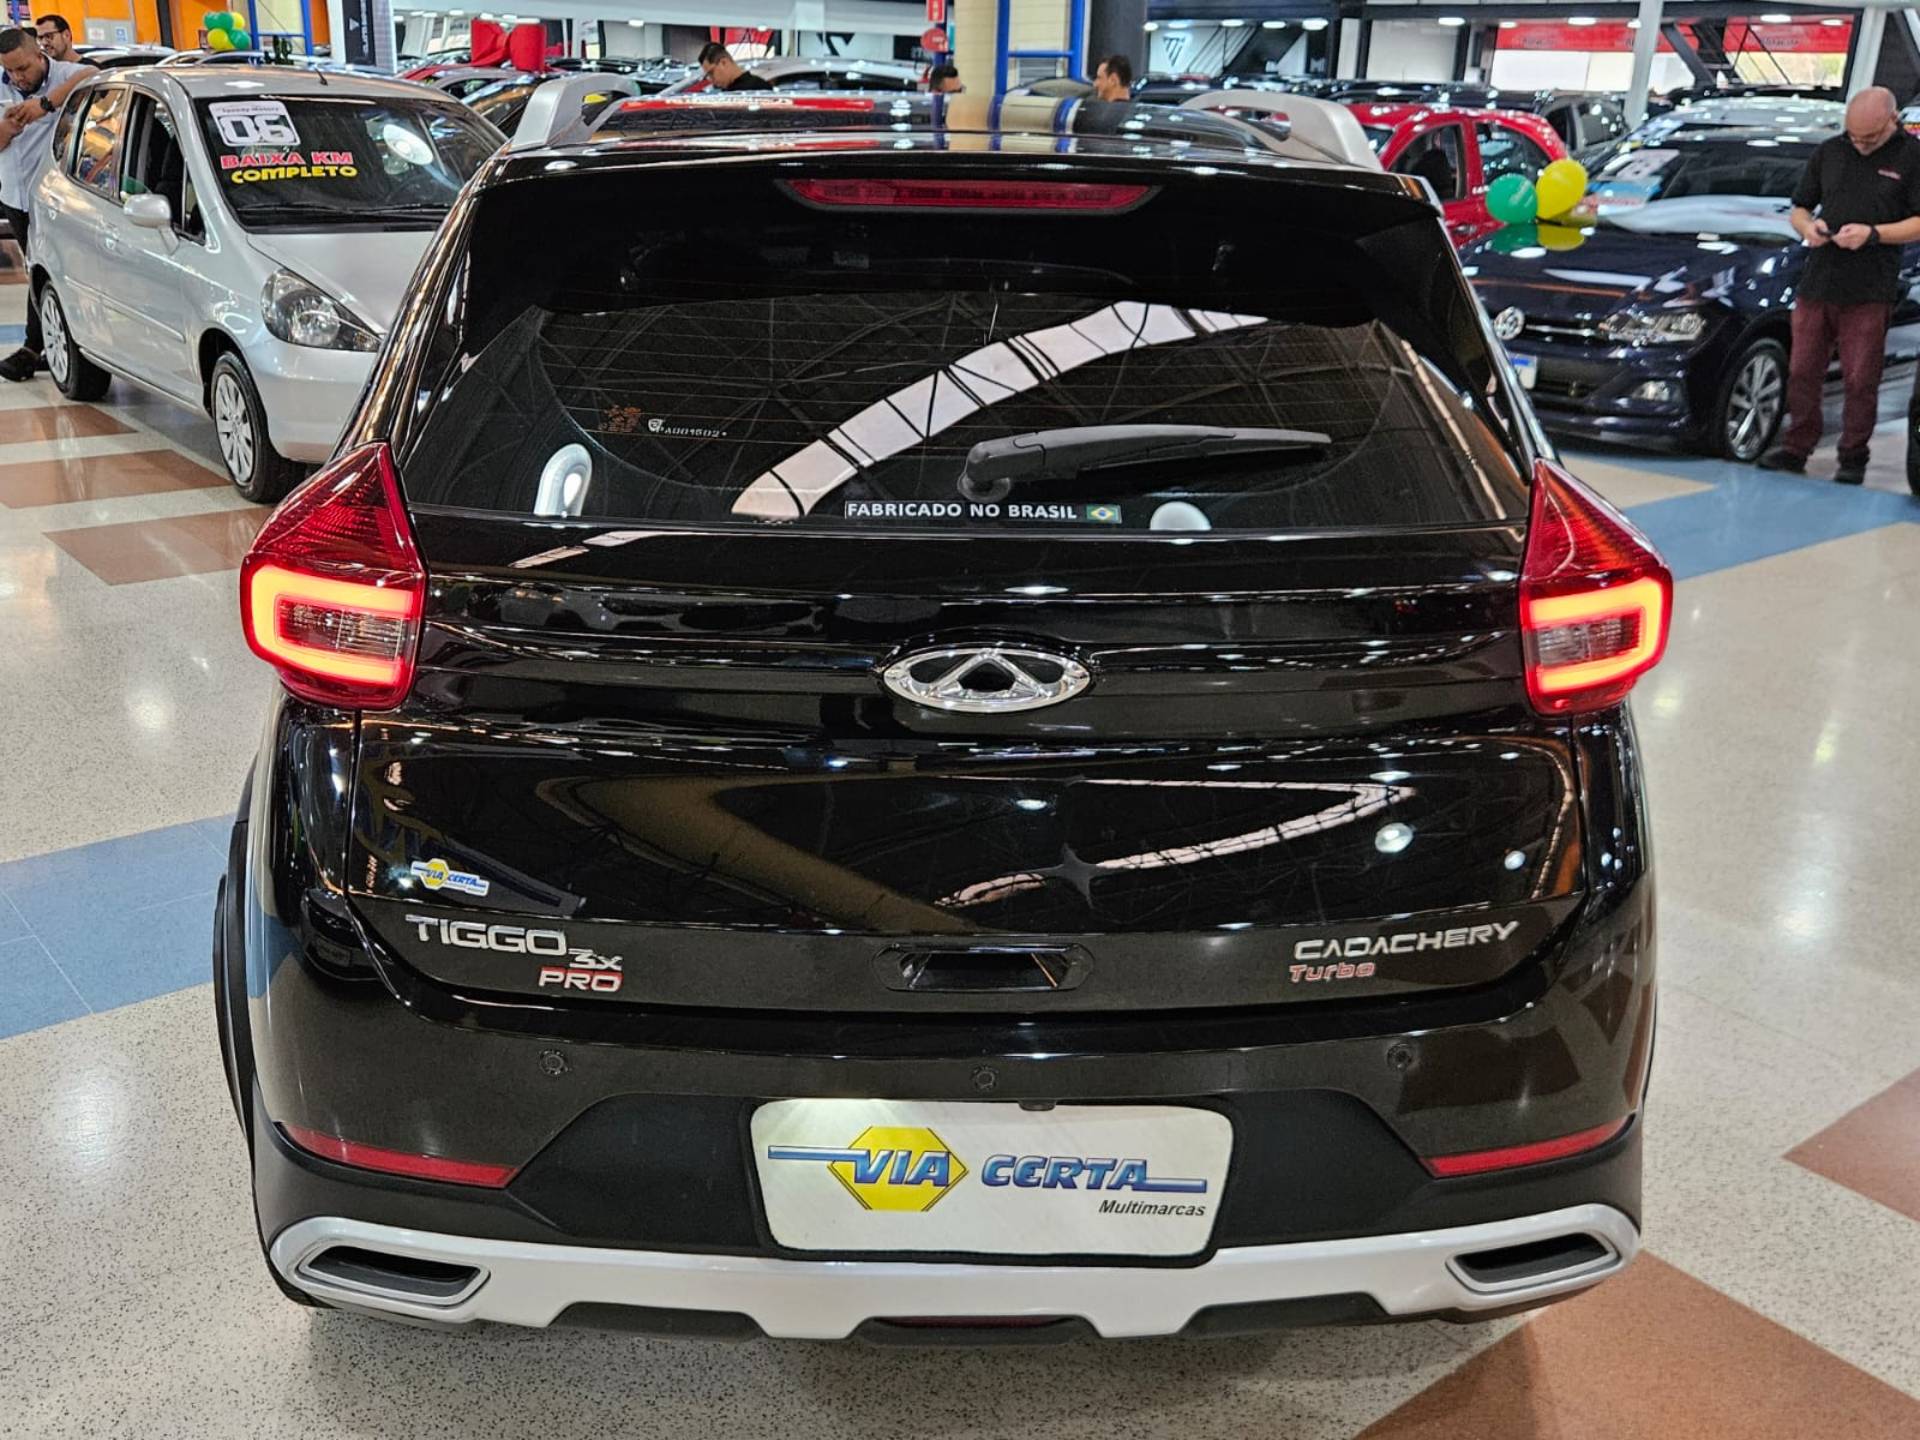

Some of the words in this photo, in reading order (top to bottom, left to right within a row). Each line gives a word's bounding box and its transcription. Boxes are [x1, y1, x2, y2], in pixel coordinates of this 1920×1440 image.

[220, 114, 295, 143] 06
[220, 152, 306, 169] BAIXA
[311, 151, 354, 165] KM
[231, 165, 358, 184] COMPLETO
[848, 503, 962, 518] FABRICADO
[970, 504, 1001, 518] NO
[1008, 504, 1077, 519] BRASIL
[405, 914, 567, 956] TIGGO
[538, 967, 624, 993] PRO
[1289, 961, 1376, 983] Turbo
[853, 1149, 952, 1187] VIA
[981, 1153, 1147, 1192] CERTA
[1098, 1199, 1206, 1217] Multimarcas
